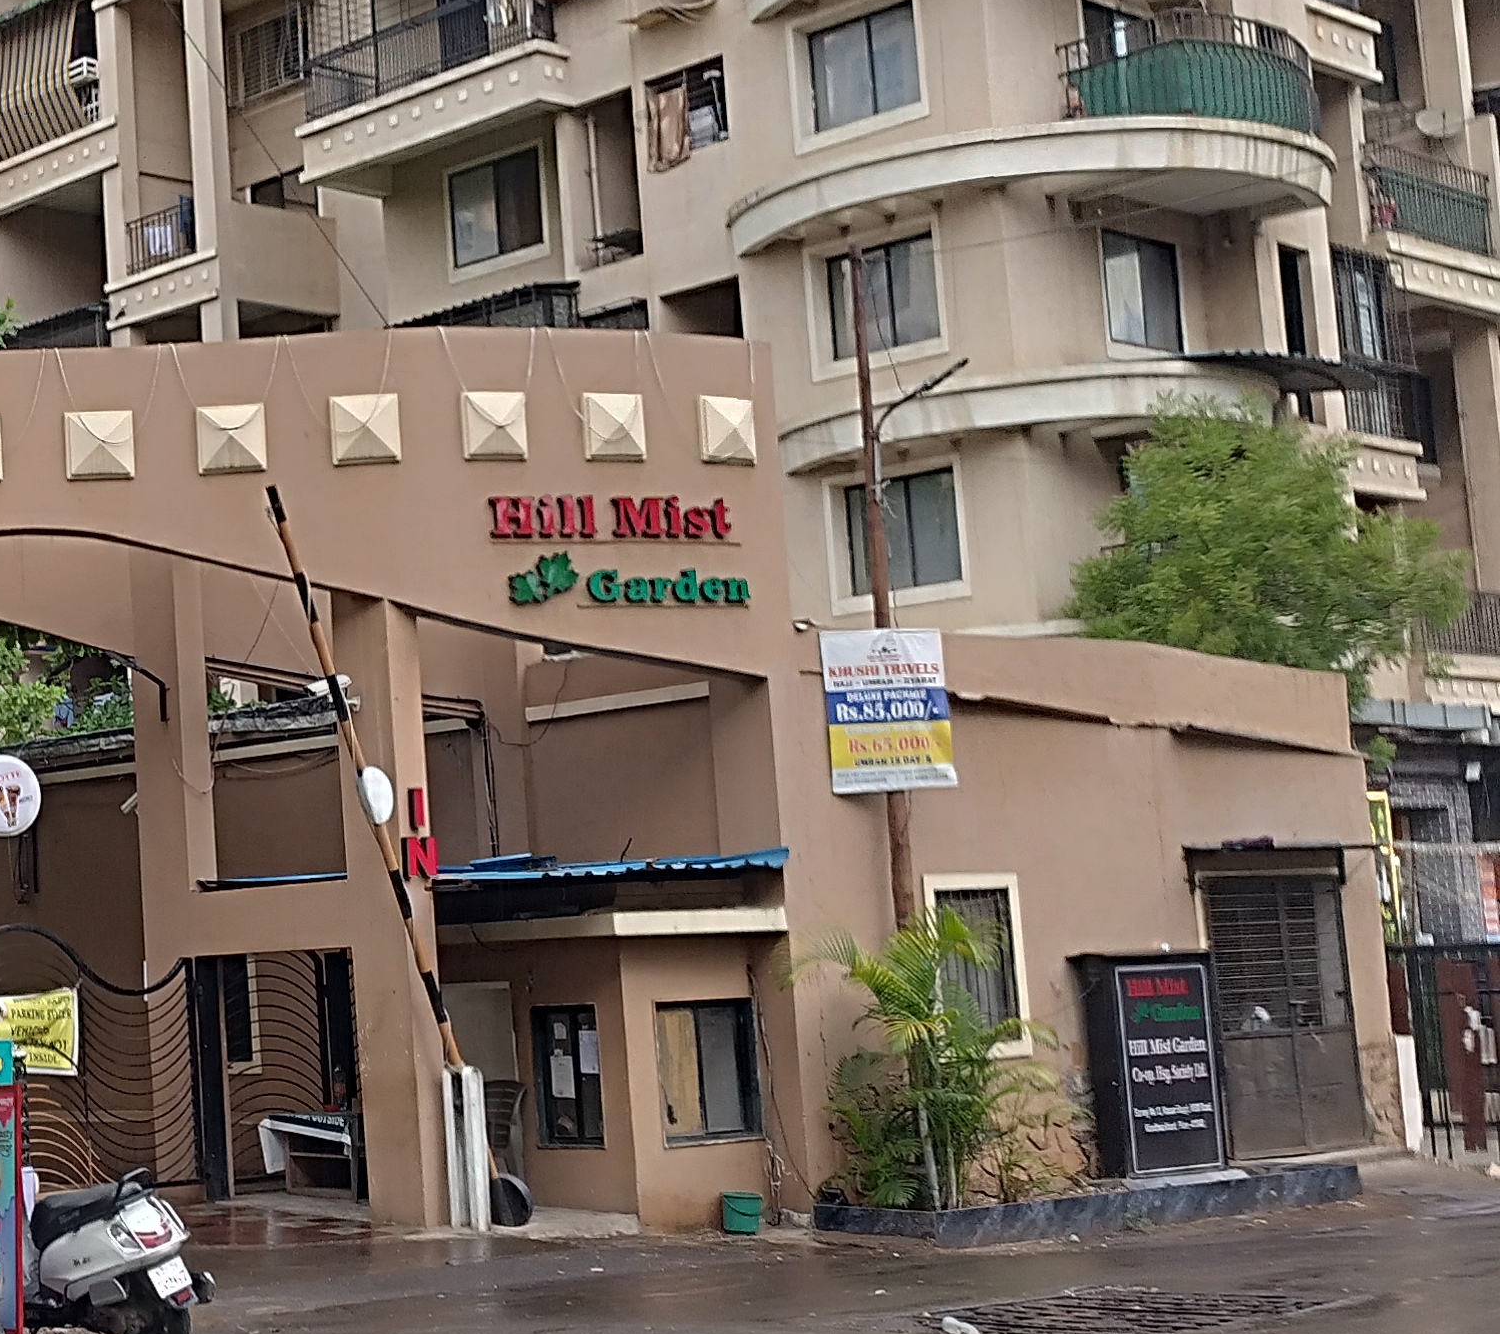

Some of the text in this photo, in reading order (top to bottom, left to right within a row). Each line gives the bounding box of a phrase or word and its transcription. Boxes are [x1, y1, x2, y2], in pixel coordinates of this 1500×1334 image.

[488, 495, 732, 539] Hill Mist
[587, 568, 750, 604] Garden
[882, 662, 940, 676] TRAVELS
[1128, 1037, 1208, 1056] Hill Mist Garden
